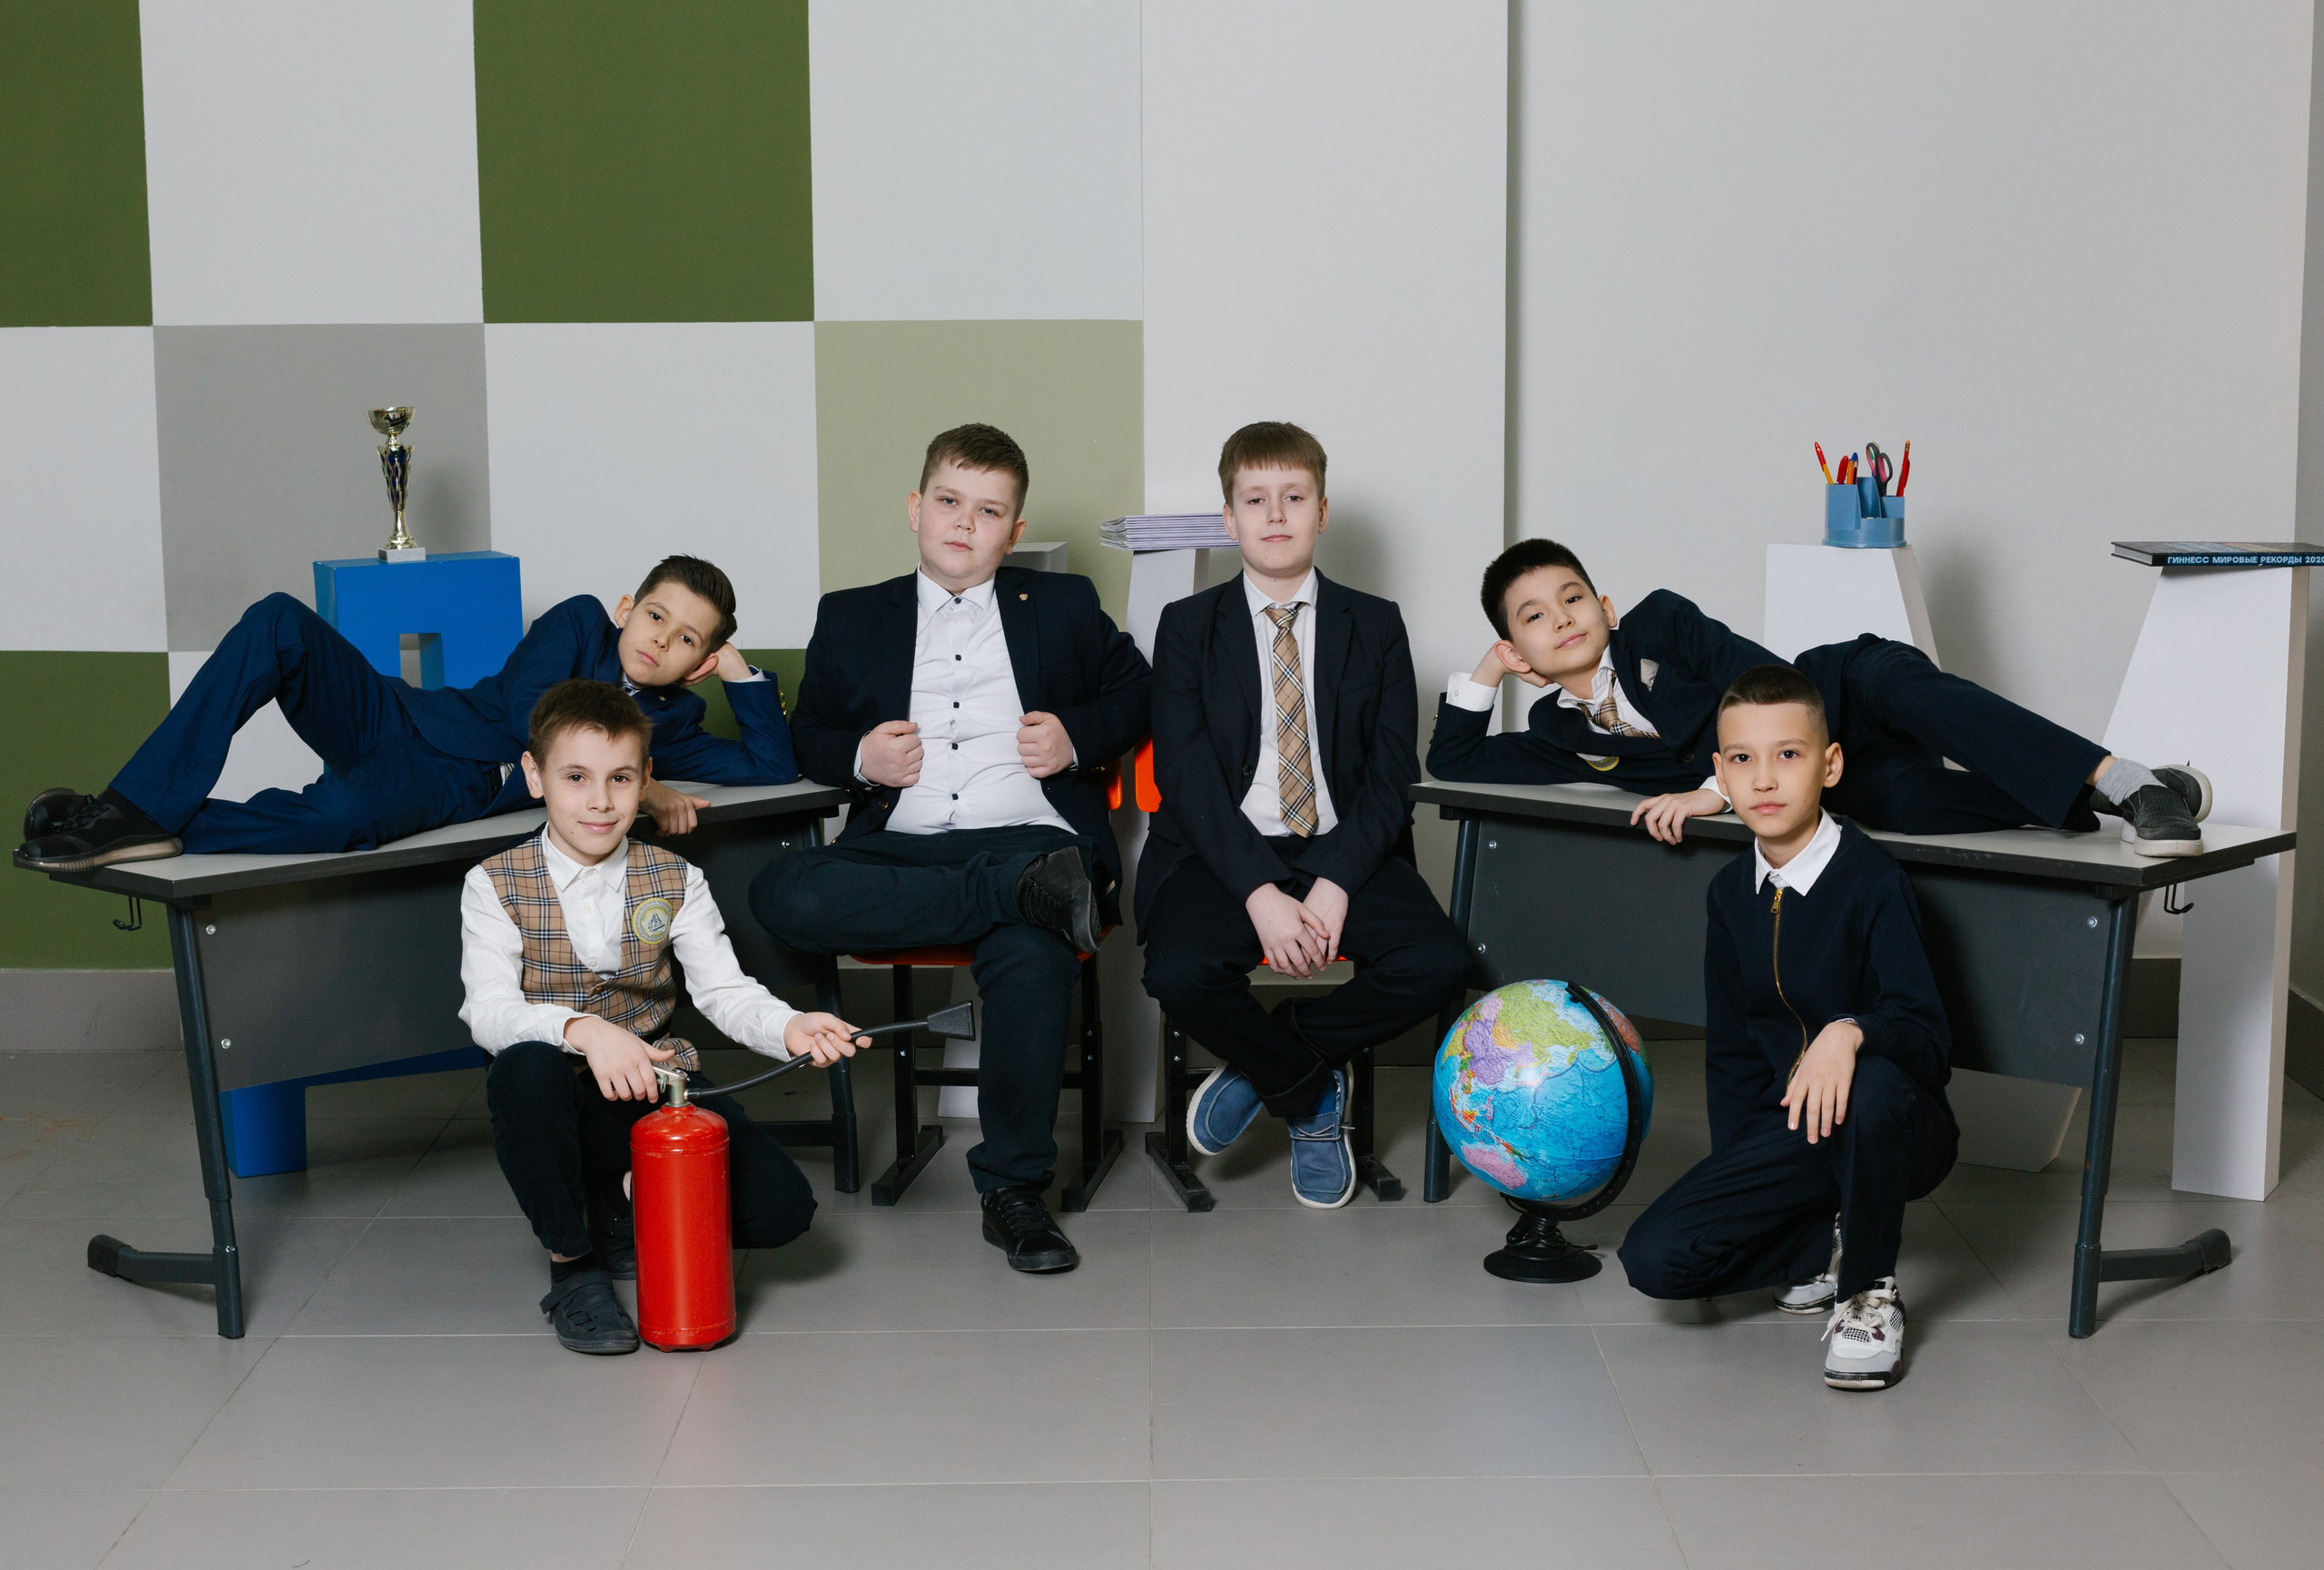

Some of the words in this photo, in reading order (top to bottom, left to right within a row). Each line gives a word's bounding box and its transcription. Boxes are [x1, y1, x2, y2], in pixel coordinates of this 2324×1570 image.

[2168, 556, 2210, 564] ГИННЕСС
[2212, 556, 2258, 564] МИРОВЫЕ
[2260, 556, 2302, 565] РЕКОРДЫ
